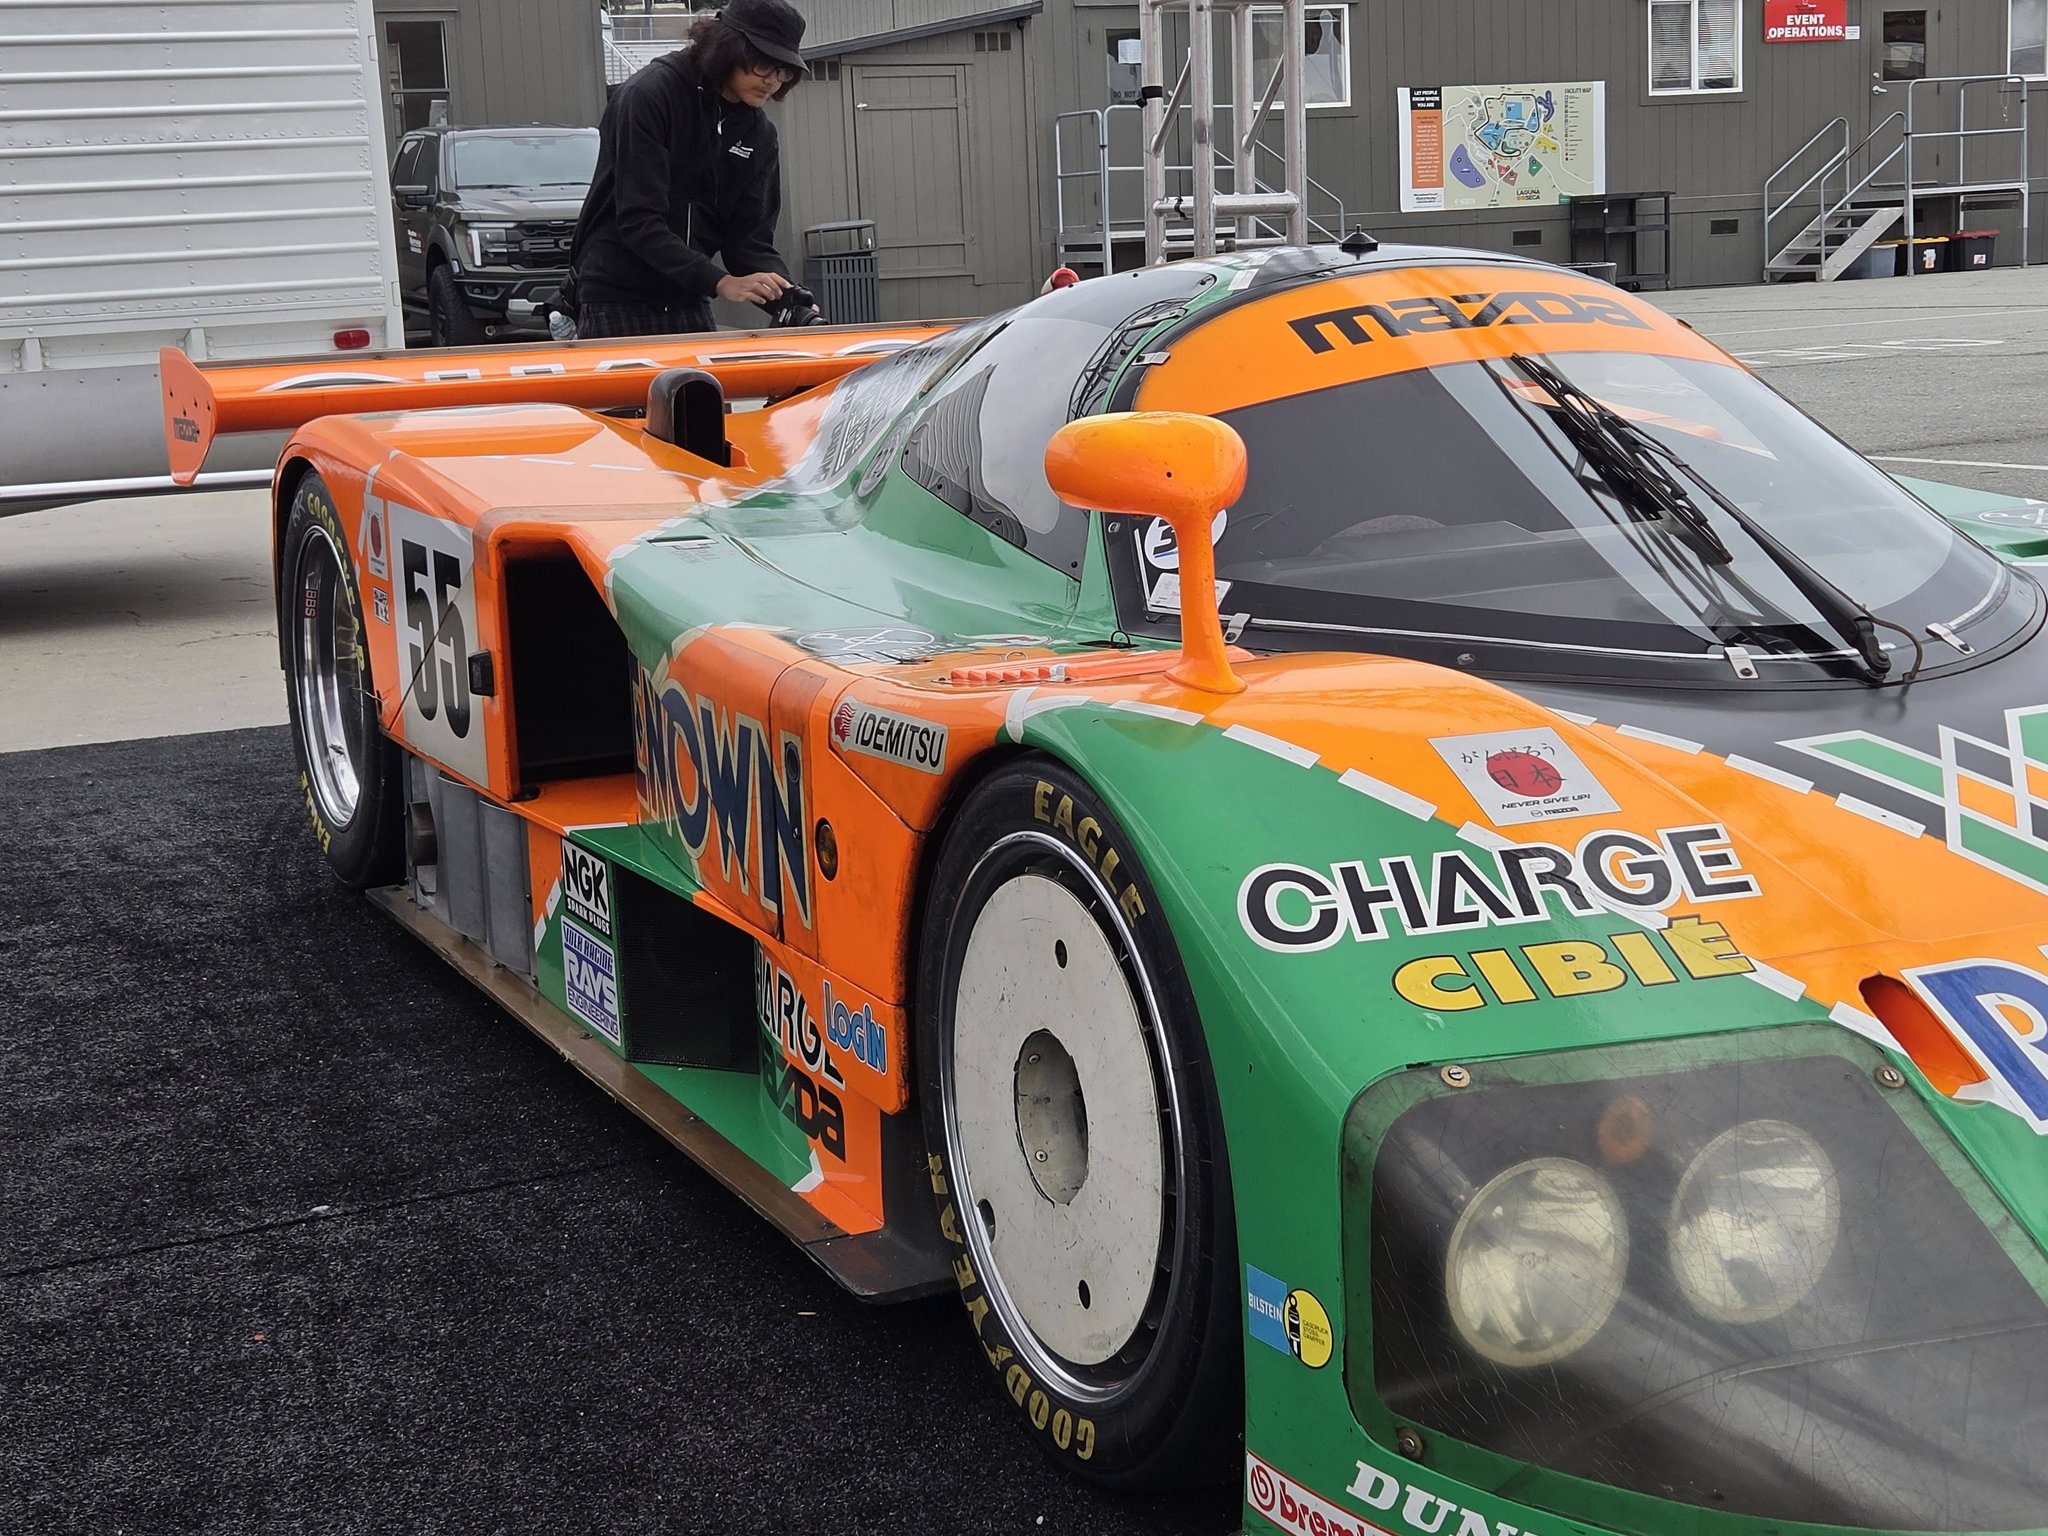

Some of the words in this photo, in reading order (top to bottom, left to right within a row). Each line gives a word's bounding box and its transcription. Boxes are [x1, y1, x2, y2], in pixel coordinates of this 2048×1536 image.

[1768, 25, 1843, 38] OPERATIONS
[1786, 13, 1826, 25] EVENT
[1286, 291, 1656, 355] mazda
[305, 589, 318, 618] BBS
[401, 538, 470, 739] 55
[854, 710, 945, 769] IDEMITSU
[629, 652, 812, 930] ENOWN
[1489, 763, 1568, 789] 日本
[1501, 798, 1540, 810] NEVER
[1542, 795, 1570, 805] GIVE
[1572, 793, 1591, 802] UP!
[1544, 806, 1580, 816] mazda
[563, 843, 608, 917] NGK
[1033, 780, 1147, 928] EAGLE
[1238, 823, 1762, 953] CHARGE
[567, 897, 588, 921] SPARK
[588, 911, 611, 936] PLUGS
[563, 924, 582, 952] VOLK
[583, 939, 613, 974] RACING
[1391, 914, 1757, 1012] CIBIÉ
[565, 947, 618, 1016] RAYS
[567, 986, 619, 1036] ENGINEERING
[1248, 1291, 1284, 1324] BILSTEIN
[1346, 1460, 1541, 1536] DUN
